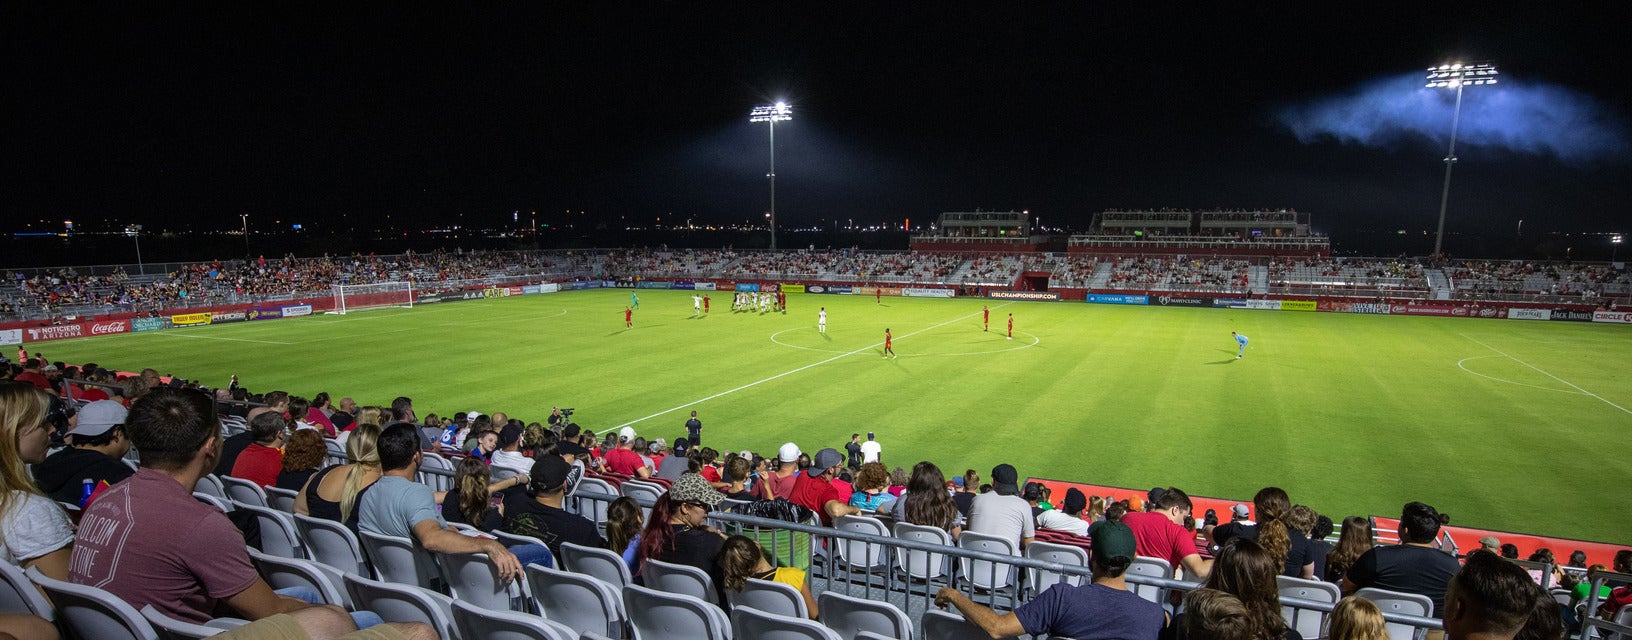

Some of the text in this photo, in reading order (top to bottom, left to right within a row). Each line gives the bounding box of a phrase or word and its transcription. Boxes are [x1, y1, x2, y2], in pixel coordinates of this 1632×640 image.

[991, 291, 1057, 300] USLCHAMPIONSHIP.COM
[1569, 312, 1593, 320] DANIEL'S
[42, 324, 81, 334] NOTICIERO
[43, 331, 82, 340] ARIZONA
